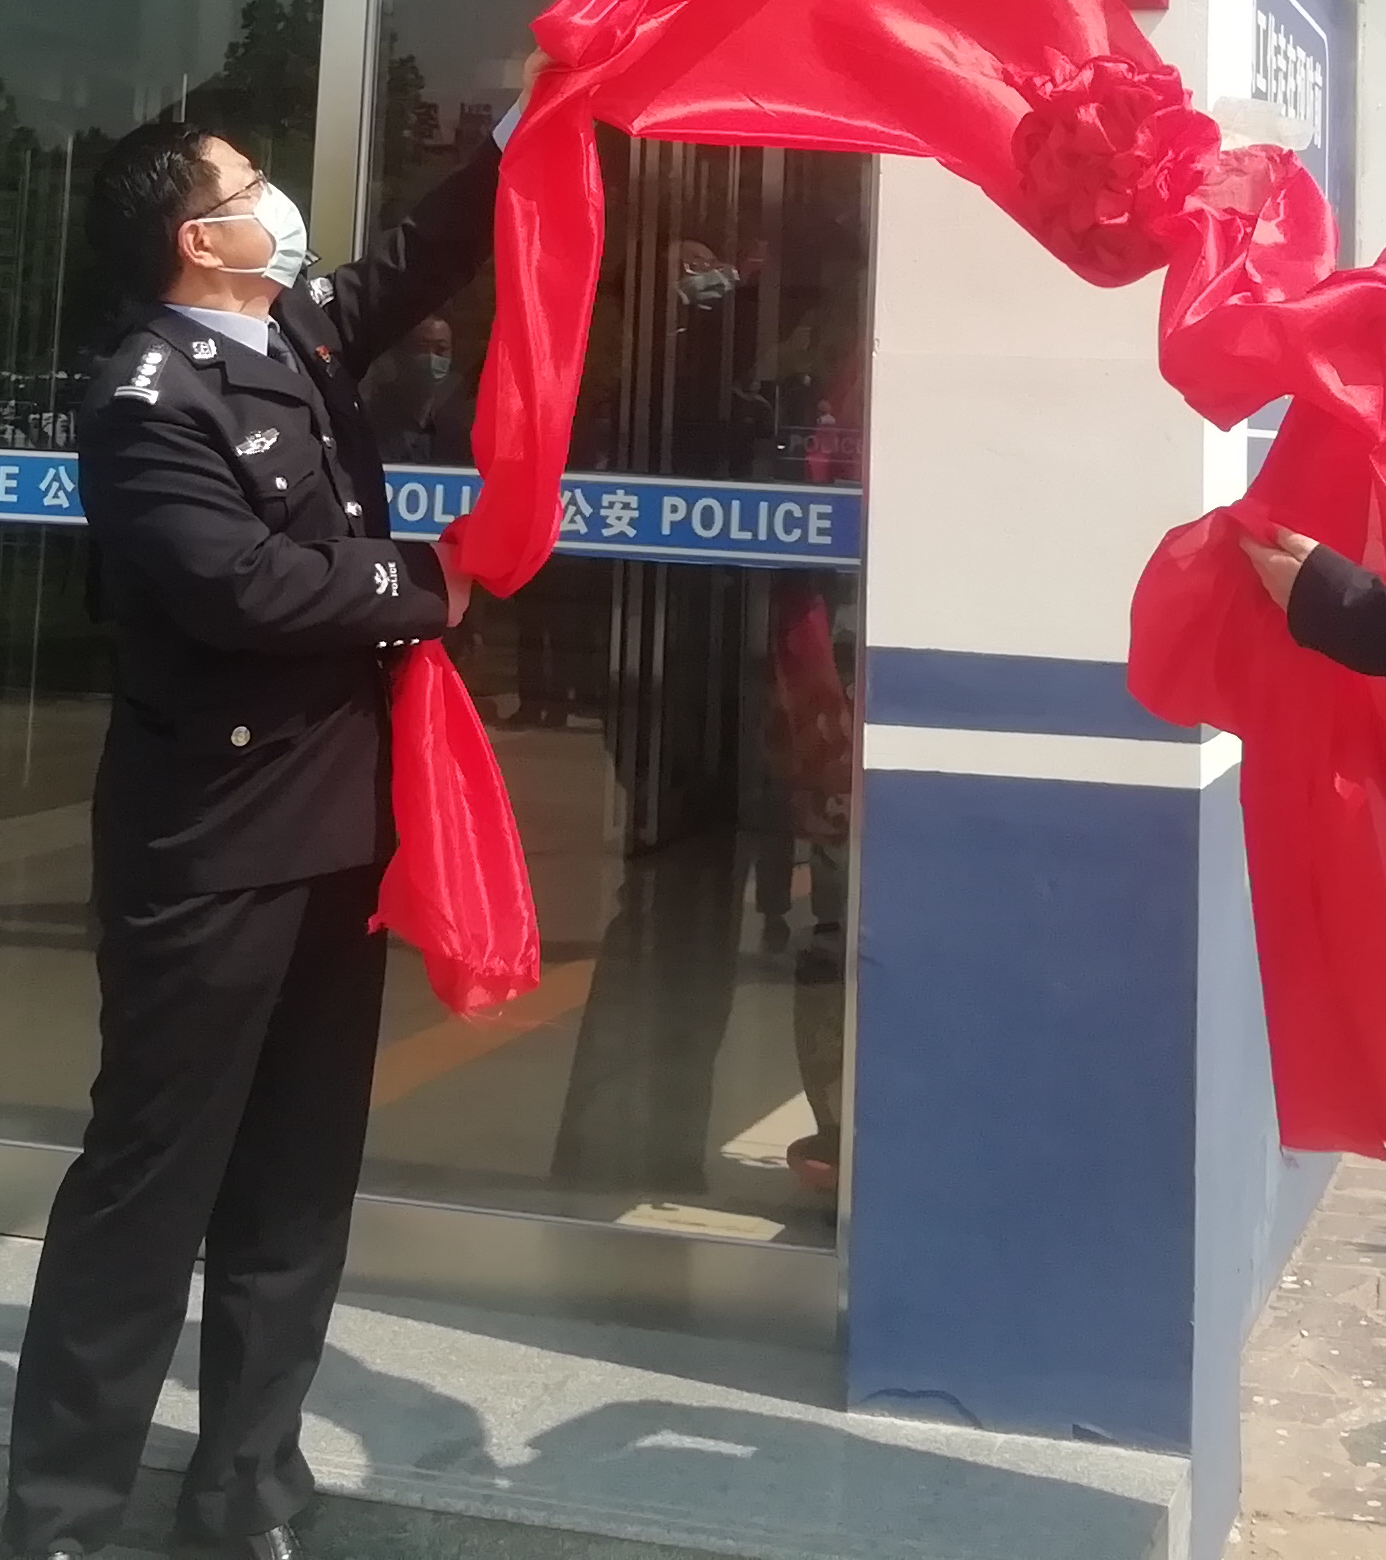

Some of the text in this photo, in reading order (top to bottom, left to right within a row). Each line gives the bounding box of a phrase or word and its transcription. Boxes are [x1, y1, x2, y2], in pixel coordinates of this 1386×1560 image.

[386, 481, 833, 545] OLI 公安 POLICE
